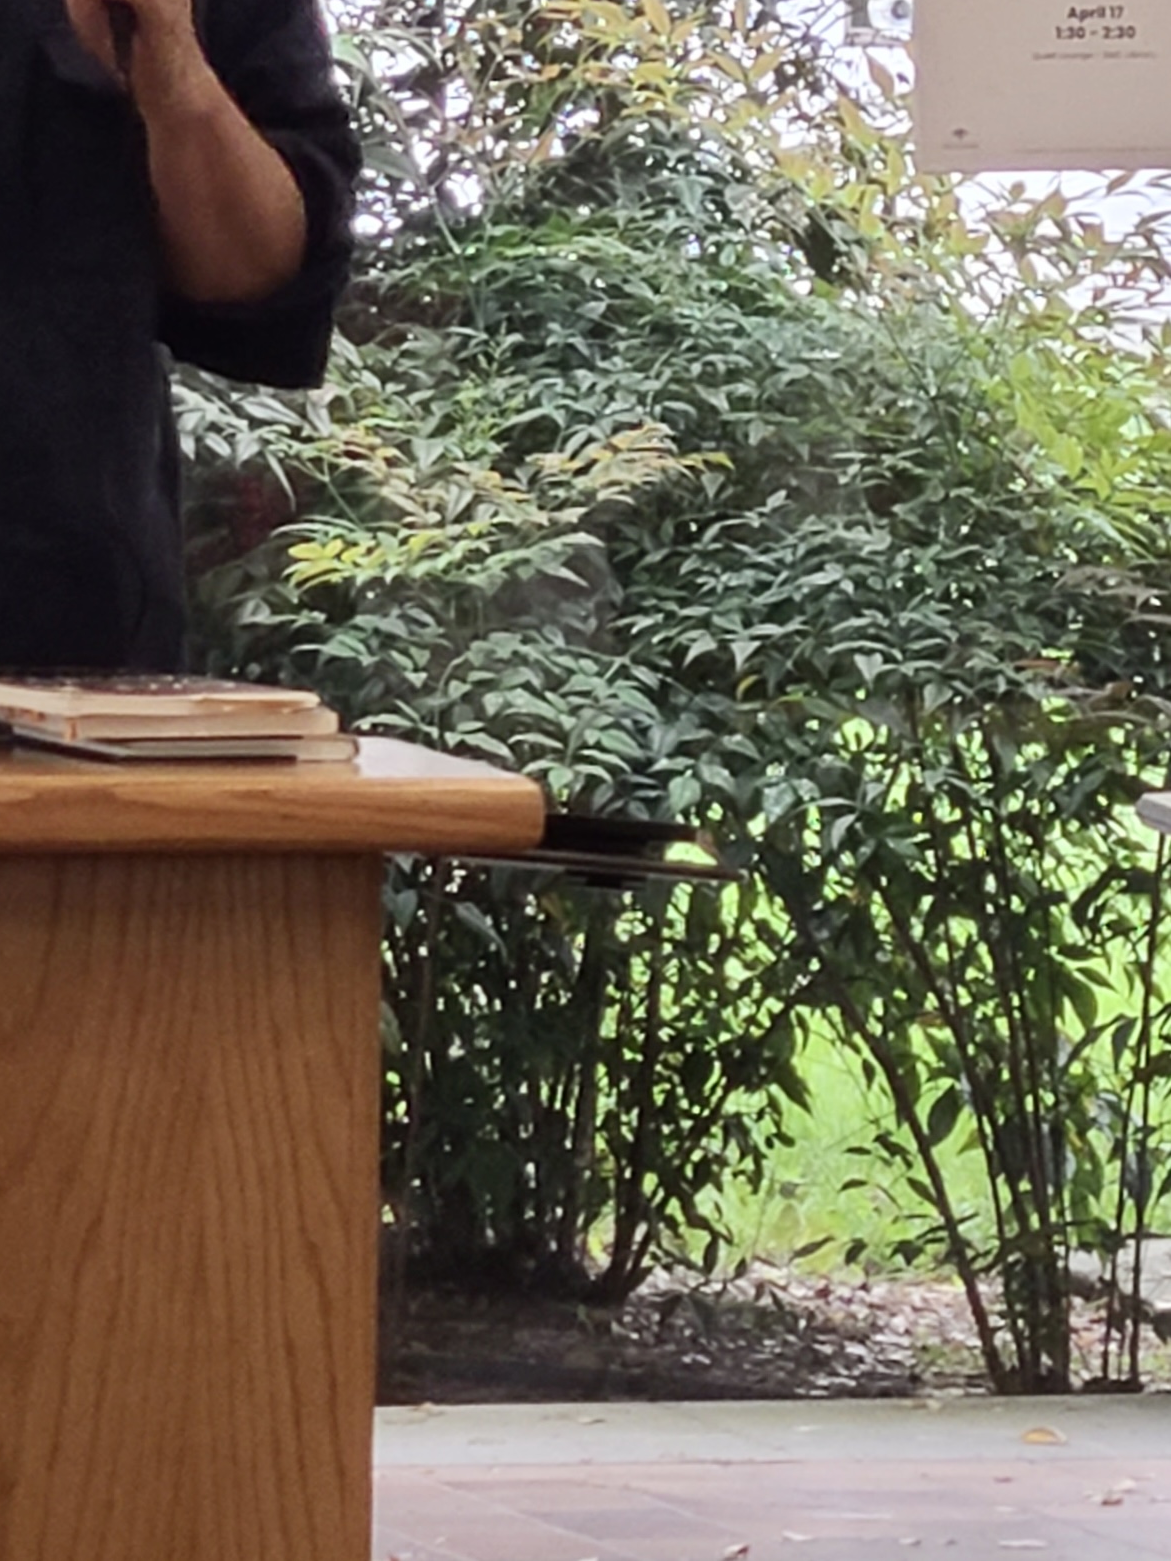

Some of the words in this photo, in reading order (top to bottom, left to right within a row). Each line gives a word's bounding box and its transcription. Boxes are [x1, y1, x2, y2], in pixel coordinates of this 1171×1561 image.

[1067, 6, 1106, 23] April
[1109, 5, 1125, 19] 17
[1055, 25, 1086, 39] 1:30
[1101, 25, 1137, 39] 2:30
